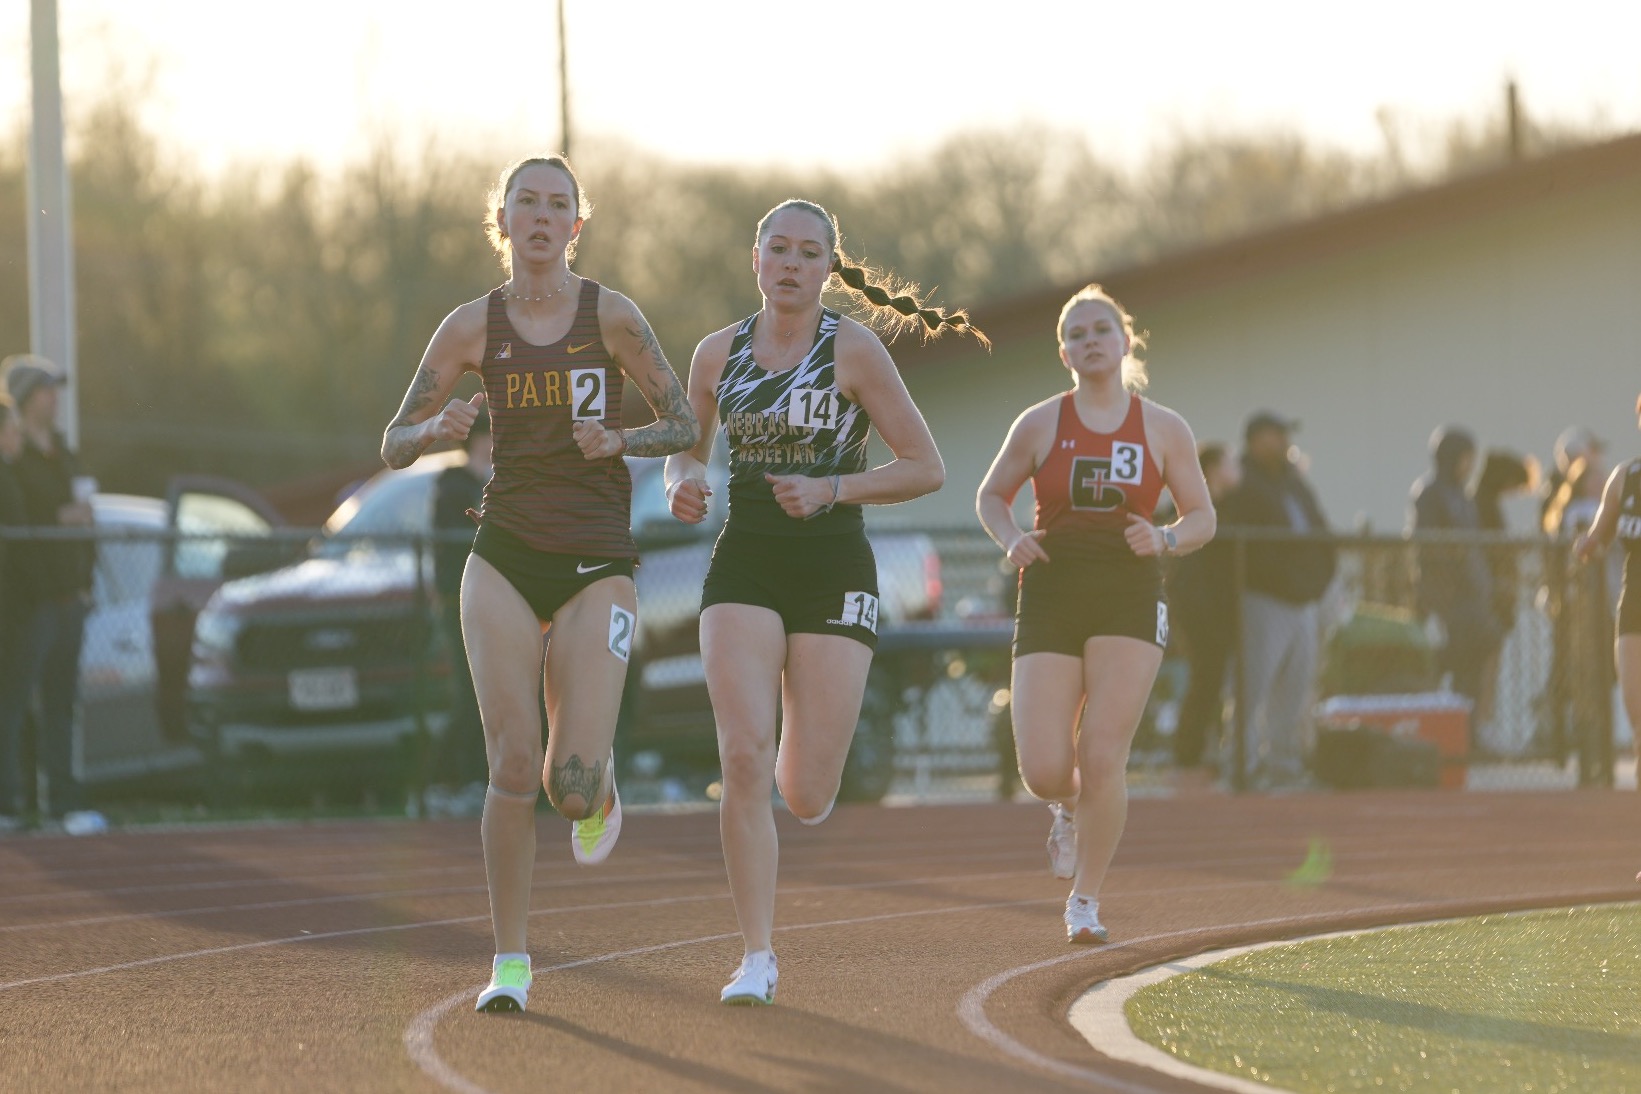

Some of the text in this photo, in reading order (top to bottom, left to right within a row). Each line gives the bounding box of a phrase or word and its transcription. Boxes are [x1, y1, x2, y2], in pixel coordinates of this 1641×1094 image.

[576, 373, 602, 418] 2
[799, 391, 831, 426] 14
[737, 443, 816, 463] WESLEYAN
[1115, 446, 1138, 480] 3
[854, 593, 875, 630] 14
[611, 611, 630, 657] 2
